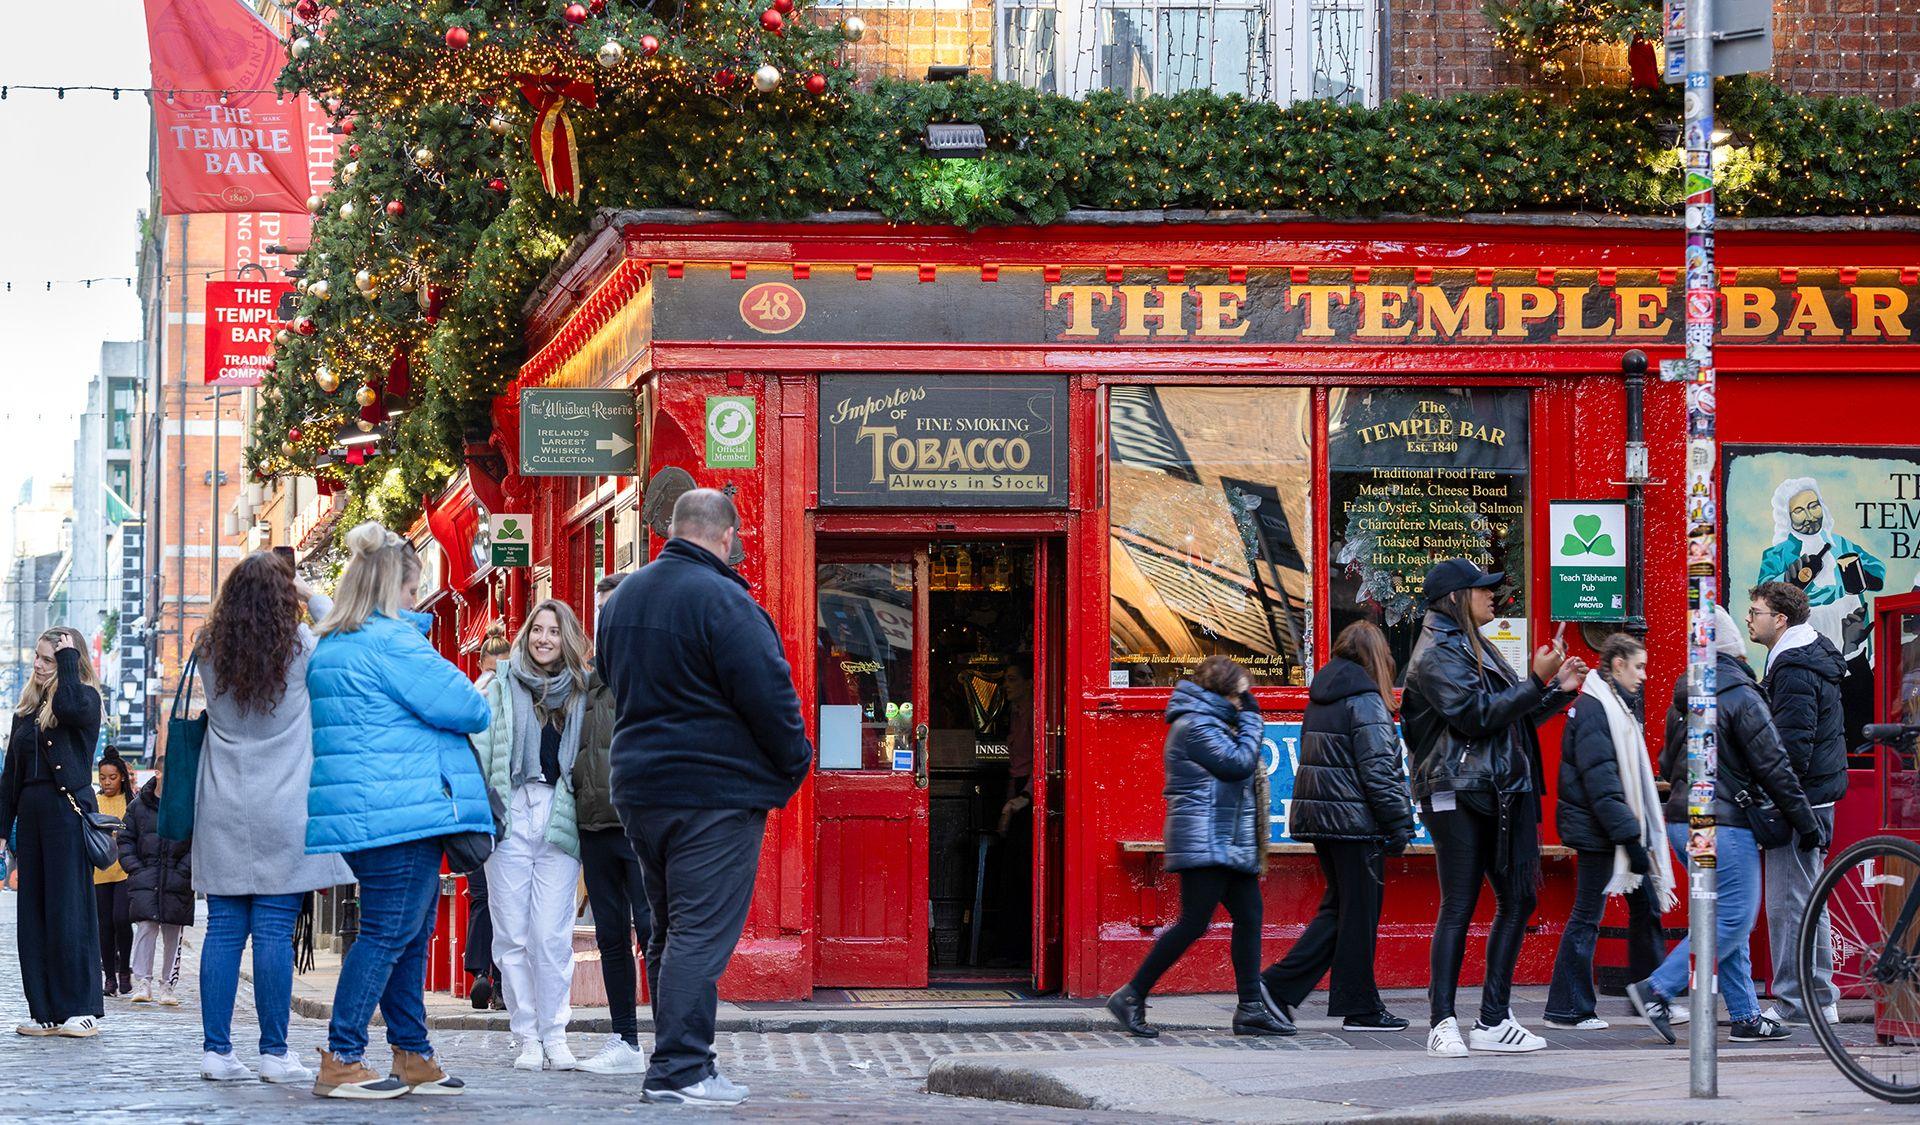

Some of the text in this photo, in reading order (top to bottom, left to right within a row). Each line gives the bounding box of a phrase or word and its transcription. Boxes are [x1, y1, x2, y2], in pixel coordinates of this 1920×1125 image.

[205, 105, 253, 125] THE
[169, 125, 292, 153] TEMPLE
[204, 152, 270, 175] BAR
[308, 122, 334, 194] THE
[234, 288, 272, 304] THE
[751, 289, 792, 321] 48
[1050, 284, 1912, 339] THE TEMPLE BAR
[215, 308, 287, 324] TEMPL
[231, 327, 272, 343] BAR
[223, 354, 272, 366] TRADIN
[219, 368, 272, 379] COMPA
[528, 399, 633, 420] The Whiskey Reserve
[829, 385, 926, 426] Importers
[1419, 400, 1446, 414] The
[890, 409, 907, 420] OF
[916, 417, 1030, 431] FINE SMOKING
[1357, 418, 1507, 447] TEMPLE BAR
[541, 438, 586, 446] LARGEST
[1407, 441, 1458, 452] Est. 1840
[540, 446, 587, 454] WHISKEY
[716, 445, 745, 453] Official
[855, 425, 1031, 484] TOBACCO
[532, 455, 595, 463] COLLECTION
[714, 453, 748, 461] Member
[1371, 467, 1496, 479] Traditional Food Fare
[891, 475, 1046, 490] Always in Stock
[1359, 484, 1507, 498] Meat Plate, Cheese Board
[1343, 501, 1375, 513] Fresh
[1429, 501, 1477, 513] Smoked
[1479, 502, 1524, 514] Salmon
[1358, 518, 1508, 531] Charcuterie Meats, Olives
[1375, 536, 1492, 548] Toasted Sandwiches
[1372, 553, 1394, 564] Hot
[1398, 553, 1431, 565] Roast
[1559, 573, 1617, 582] Teach Tábhairne
[1581, 583, 1596, 592] Pub
[1151, 653, 1170, 664] lived
[1170, 654, 1186, 664] and
[1254, 654, 1269, 664] and
[1269, 667, 1284, 676] 1938
[975, 744, 1009, 755] INNES
